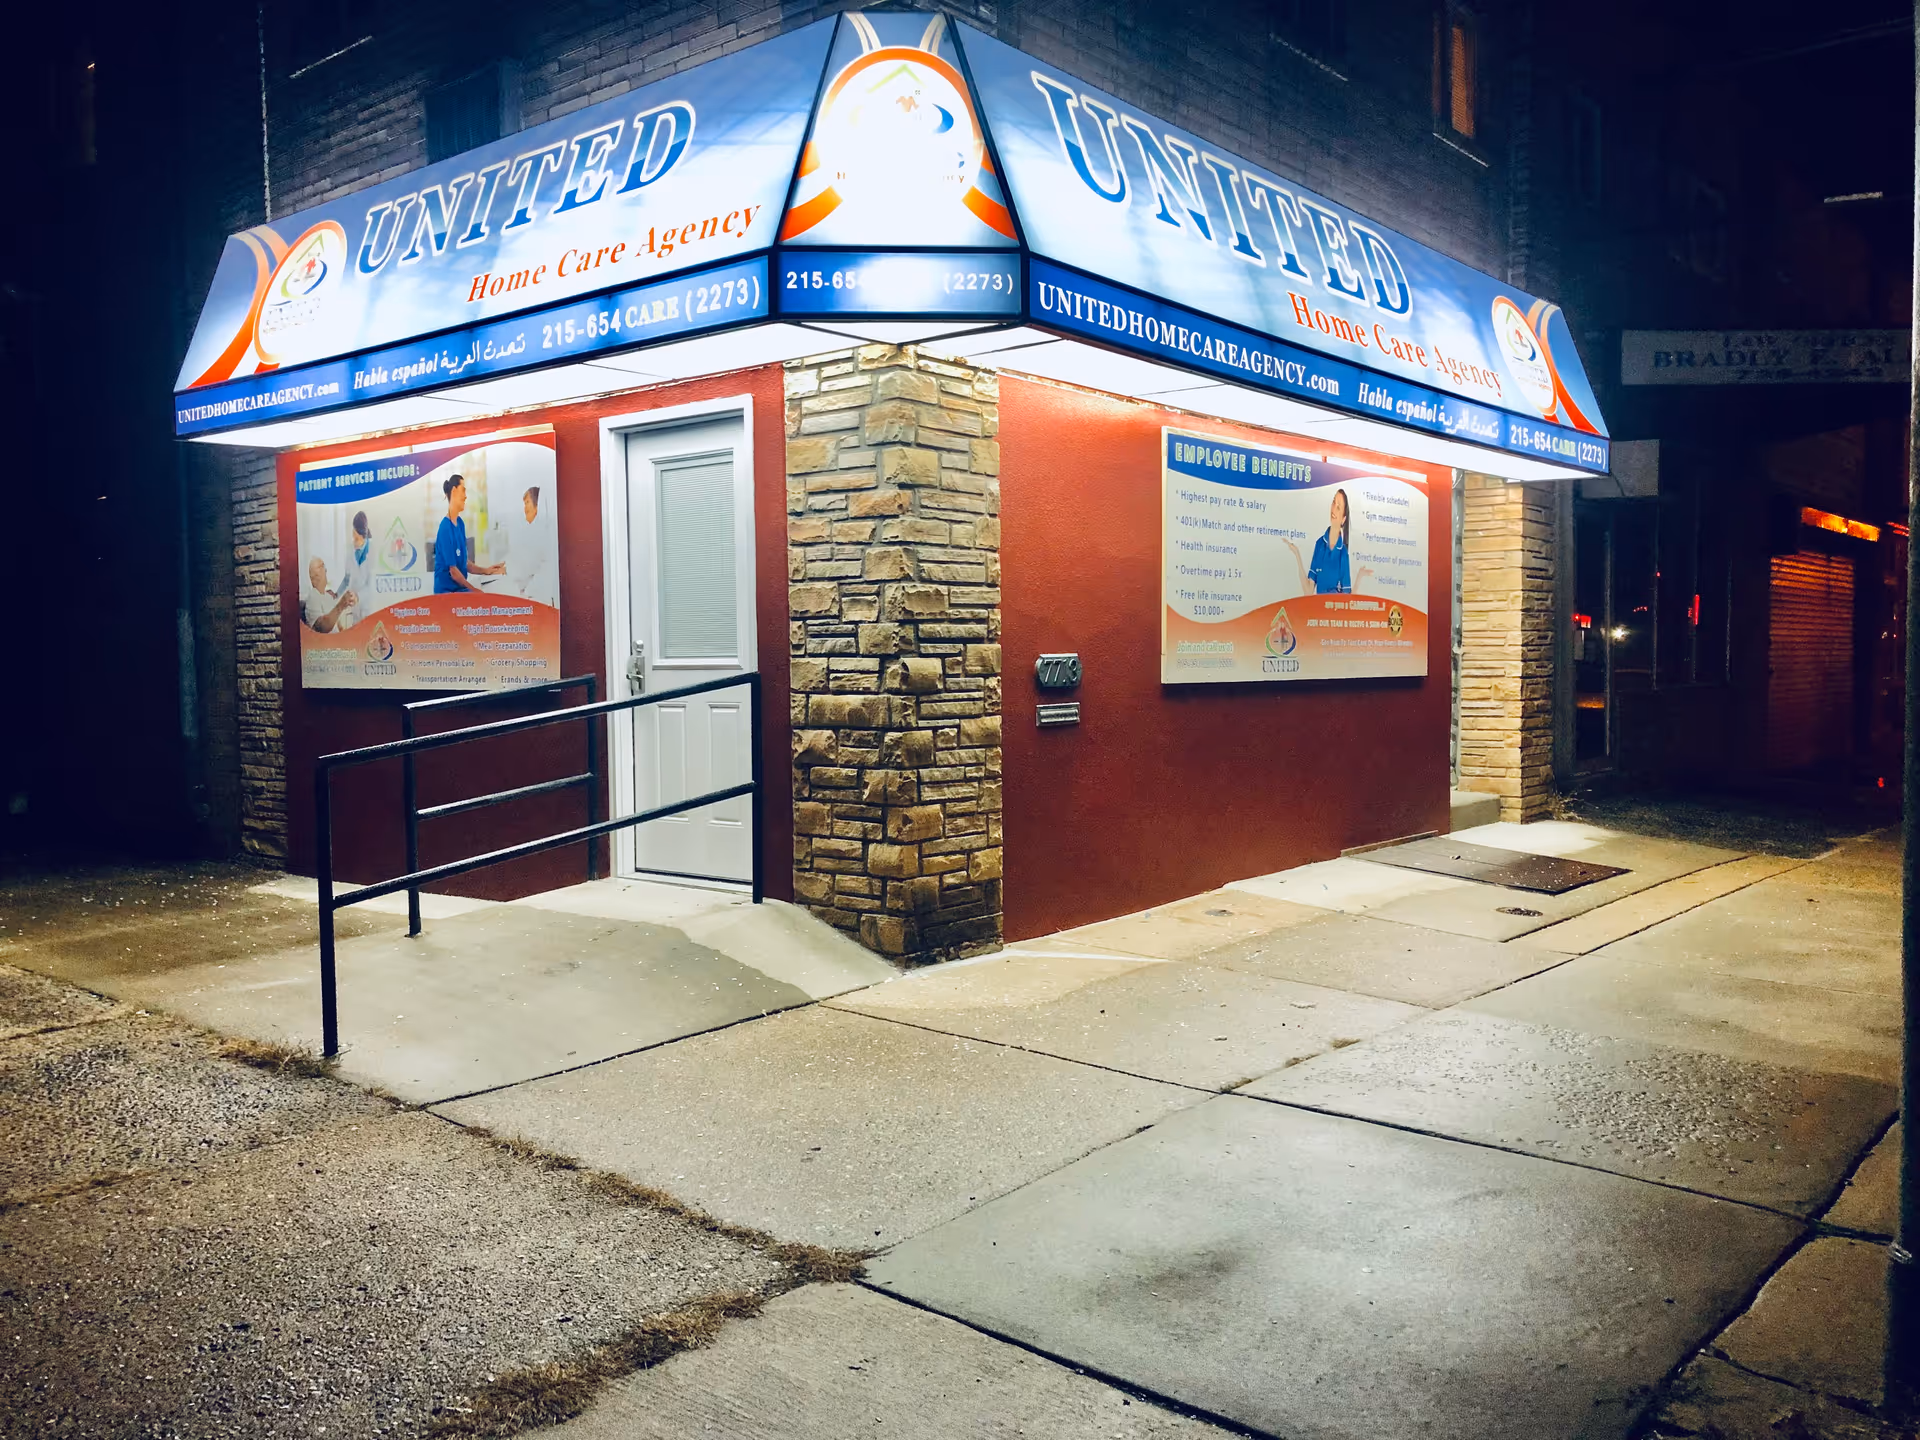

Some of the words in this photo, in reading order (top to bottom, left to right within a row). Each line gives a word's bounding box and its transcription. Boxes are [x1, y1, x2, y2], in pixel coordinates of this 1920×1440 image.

[354, 100, 696, 278] UNITED
[1031, 70, 1413, 321] UNITED
[466, 262, 546, 303] Home
[557, 241, 627, 278] Care
[634, 204, 761, 258] Agency
[943, 273, 1014, 295] (2273)
[542, 310, 621, 349] 215-654
[624, 295, 679, 329] CARE
[685, 275, 761, 322] (2273)
[1038, 281, 1340, 396] UNITEDHOMECAREAGENCY.com
[1287, 291, 1369, 348] Home
[1373, 323, 1429, 368] Care
[1433, 345, 1503, 398] Agency
[354, 369, 389, 390] Habla
[391, 353, 438, 386] español
[178, 381, 340, 424] UNITEDHOMECAREAGENCY.com
[1358, 382, 1393, 412] Habla
[1396, 400, 1437, 423] español
[1510, 424, 1551, 453] 215-654
[1552, 436, 1577, 457] CARE
[1577, 441, 1606, 470] (2273)
[1175, 442, 1246, 472] EMPLOYEE
[1251, 456, 1312, 483] BENEFITS
[298, 477, 333, 493] PATIENT
[335, 470, 375, 488] SERVICES
[377, 464, 420, 482] INCLUDE:
[1180, 490, 1208, 504] Highest
[1209, 496, 1221, 508] pay
[1223, 497, 1237, 507] rate
[1238, 498, 1245, 508] &
[1246, 499, 1267, 512] salary
[1366, 491, 1386, 503] Flexible
[1365, 511, 1377, 522] Gym
[1223, 522, 1236, 532] and
[1237, 522, 1255, 534] other
[1256, 525, 1289, 538] retirement
[1290, 528, 1307, 541] plans
[1180, 540, 1204, 552] Health
[1205, 542, 1238, 555] insurance
[1356, 552, 1372, 562] Direct
[1392, 556, 1397, 564] of
[1180, 564, 1213, 577] Overtime
[1214, 570, 1227, 580] pay
[1228, 567, 1242, 579] 1.5x
[376, 577, 422, 594] UNITED
[1180, 589, 1196, 600] Free
[1197, 589, 1209, 601] life
[1210, 590, 1243, 602] insurance
[456, 607, 490, 617] Medication
[491, 606, 533, 617] Management
[1193, 605, 1225, 616] $10,000+
[484, 624, 530, 635] Housekeeping
[1330, 620, 1343, 628] TEAM
[478, 642, 493, 650] Meal
[494, 641, 532, 651] Preparation
[364, 664, 397, 676] UNITED
[435, 659, 460, 668] Personal
[490, 658, 515, 669] Grocery
[516, 657, 548, 669] Shopping
[1262, 660, 1300, 673] UNITED
[416, 675, 457, 684] Transportation
[458, 675, 487, 685] Arranged
[523, 676, 530, 684] &
